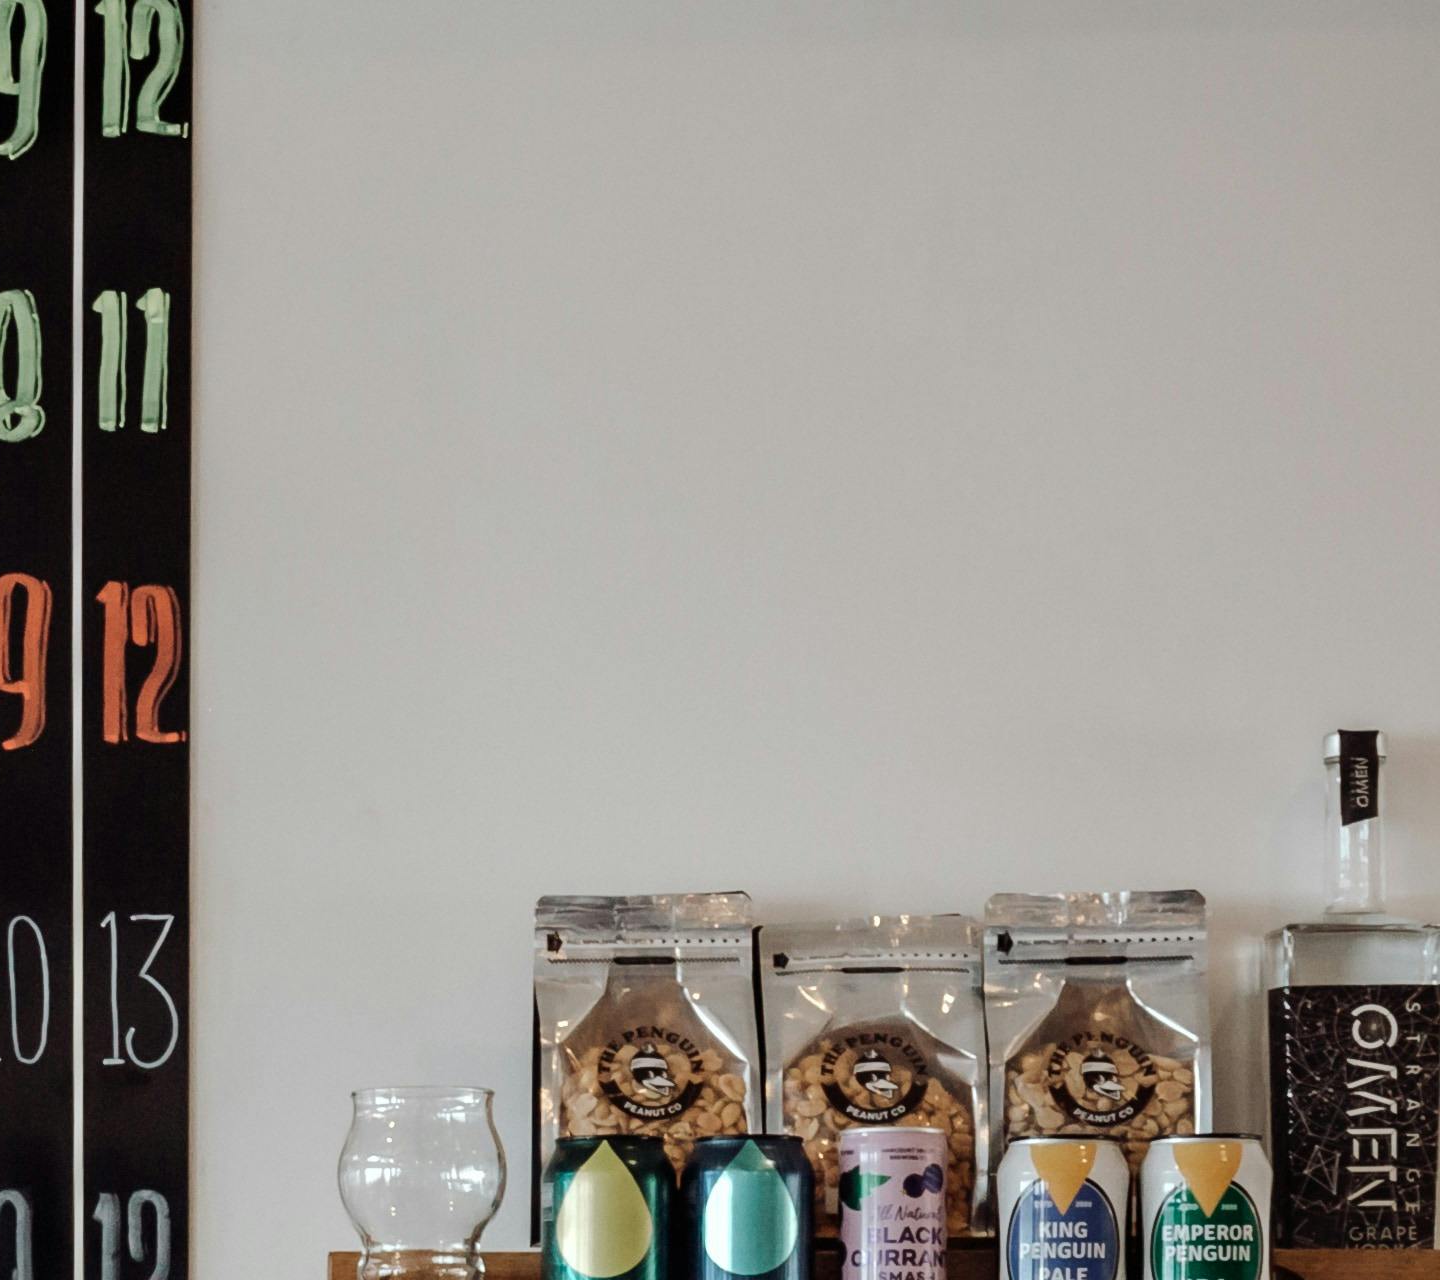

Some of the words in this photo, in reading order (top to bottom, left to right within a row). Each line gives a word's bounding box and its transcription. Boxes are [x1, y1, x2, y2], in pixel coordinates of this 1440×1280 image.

[92, 287, 170, 433] 11
[96, 580, 187, 743] 12
[1039, 1222, 1087, 1238] KING
[1161, 1224, 1253, 1241] EMPEROR
[1349, 1226, 1417, 1240] GRAPE
